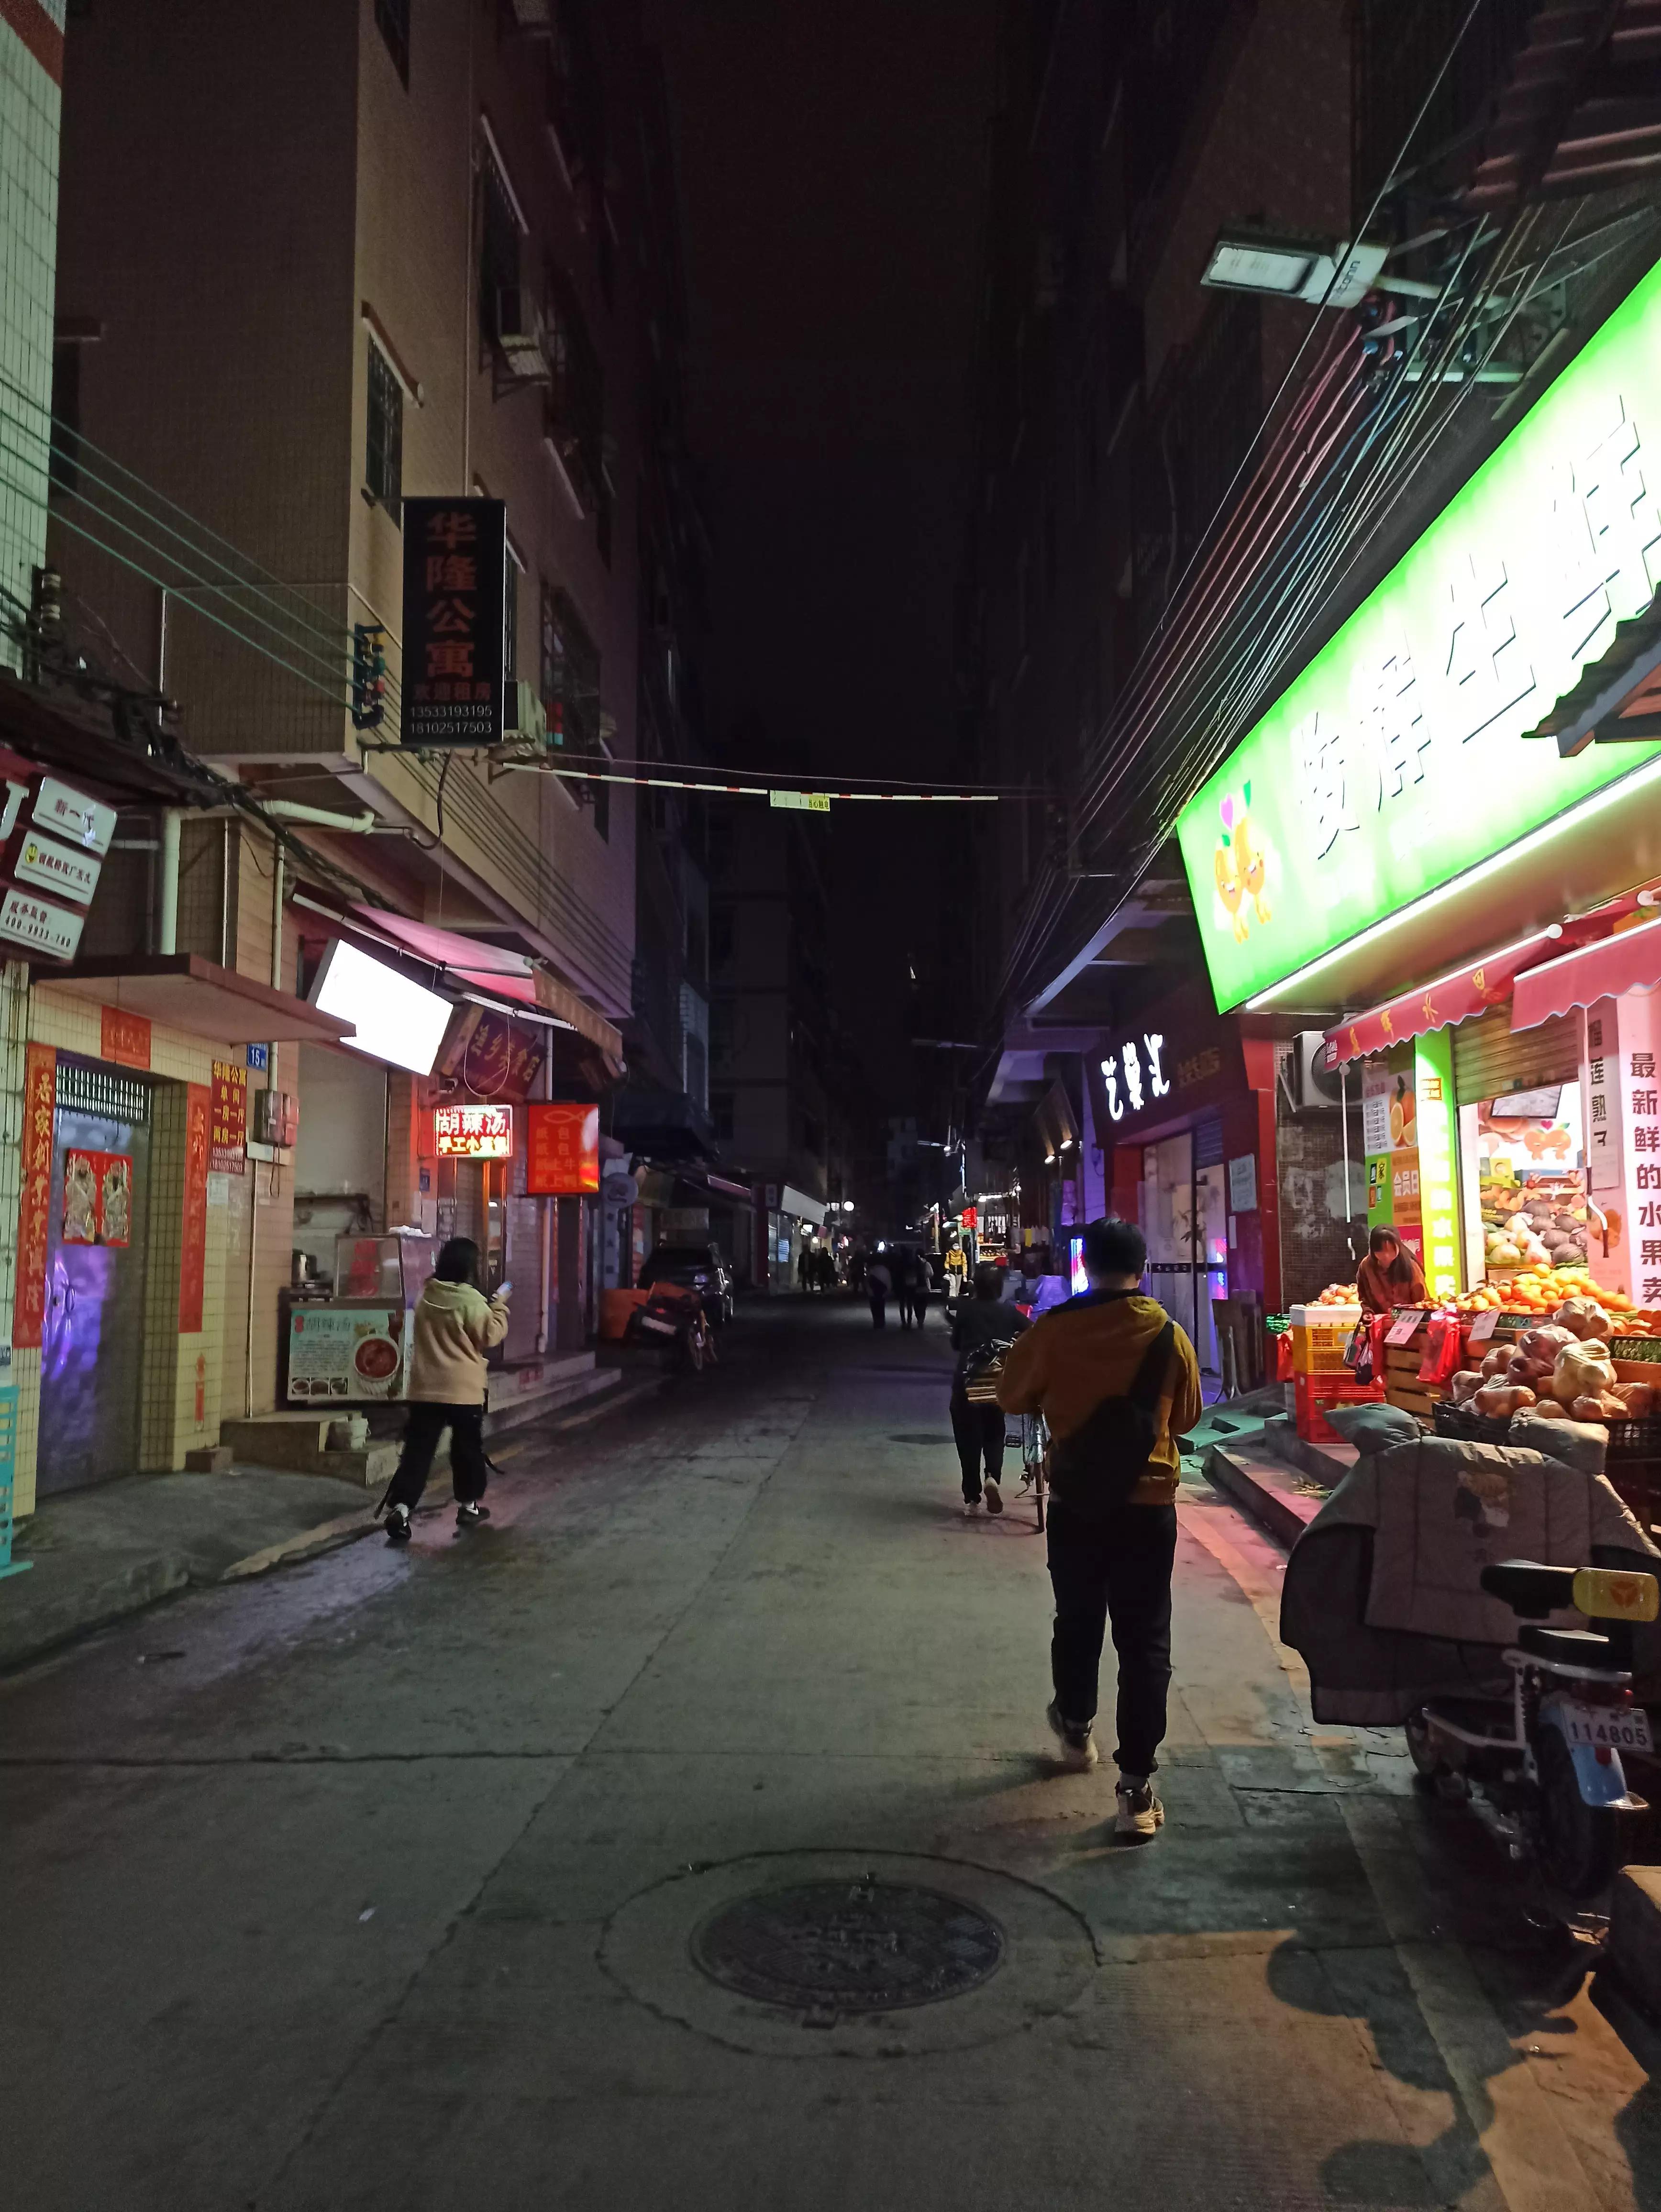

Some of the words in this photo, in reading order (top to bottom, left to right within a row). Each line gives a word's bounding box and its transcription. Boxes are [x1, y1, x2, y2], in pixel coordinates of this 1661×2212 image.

[426, 511, 476, 677] 华隆公寓
[410, 722, 492, 734] 18102517503
[809, 799, 830, 809] 当心触电
[213, 1060, 247, 1087] 华隆公寓
[221, 1084, 240, 1105] 单间
[214, 1105, 245, 1124] 一房一厅
[439, 1108, 506, 1135] 胡辣汤
[213, 1125, 244, 1147] 两房一厅
[1393, 1170, 1420, 1197] 会员日
